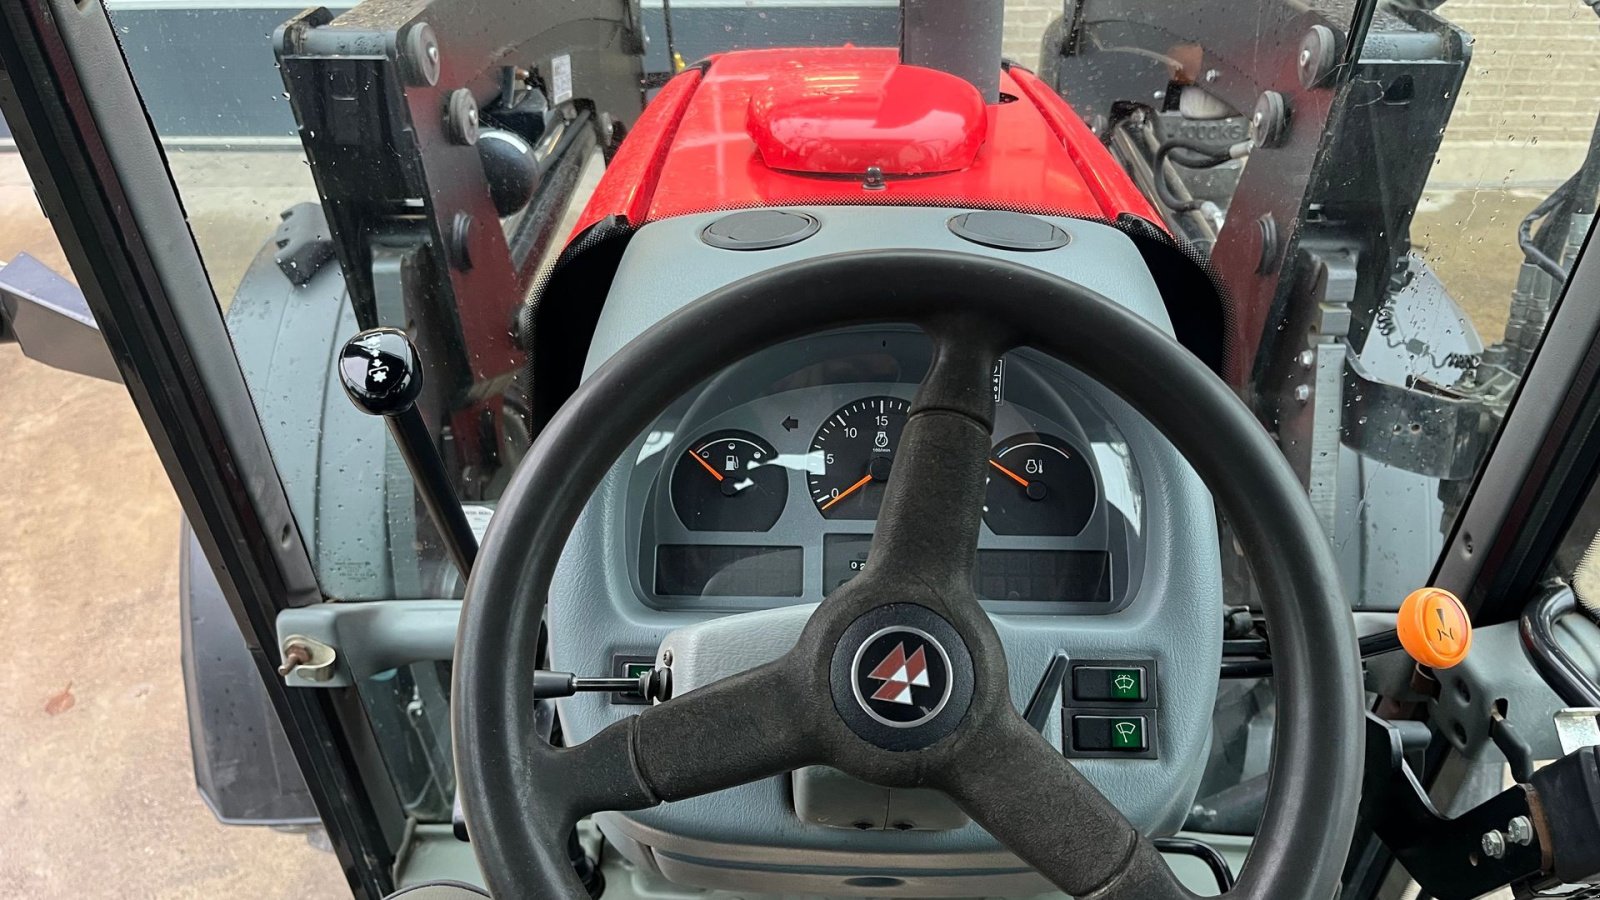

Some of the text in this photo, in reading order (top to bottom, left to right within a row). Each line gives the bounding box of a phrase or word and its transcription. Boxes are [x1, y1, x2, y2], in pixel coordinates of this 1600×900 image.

[875, 415, 889, 426] 15
[843, 427, 858, 439] 10
[826, 453, 835, 465] 5
[831, 488, 839, 499] 0
